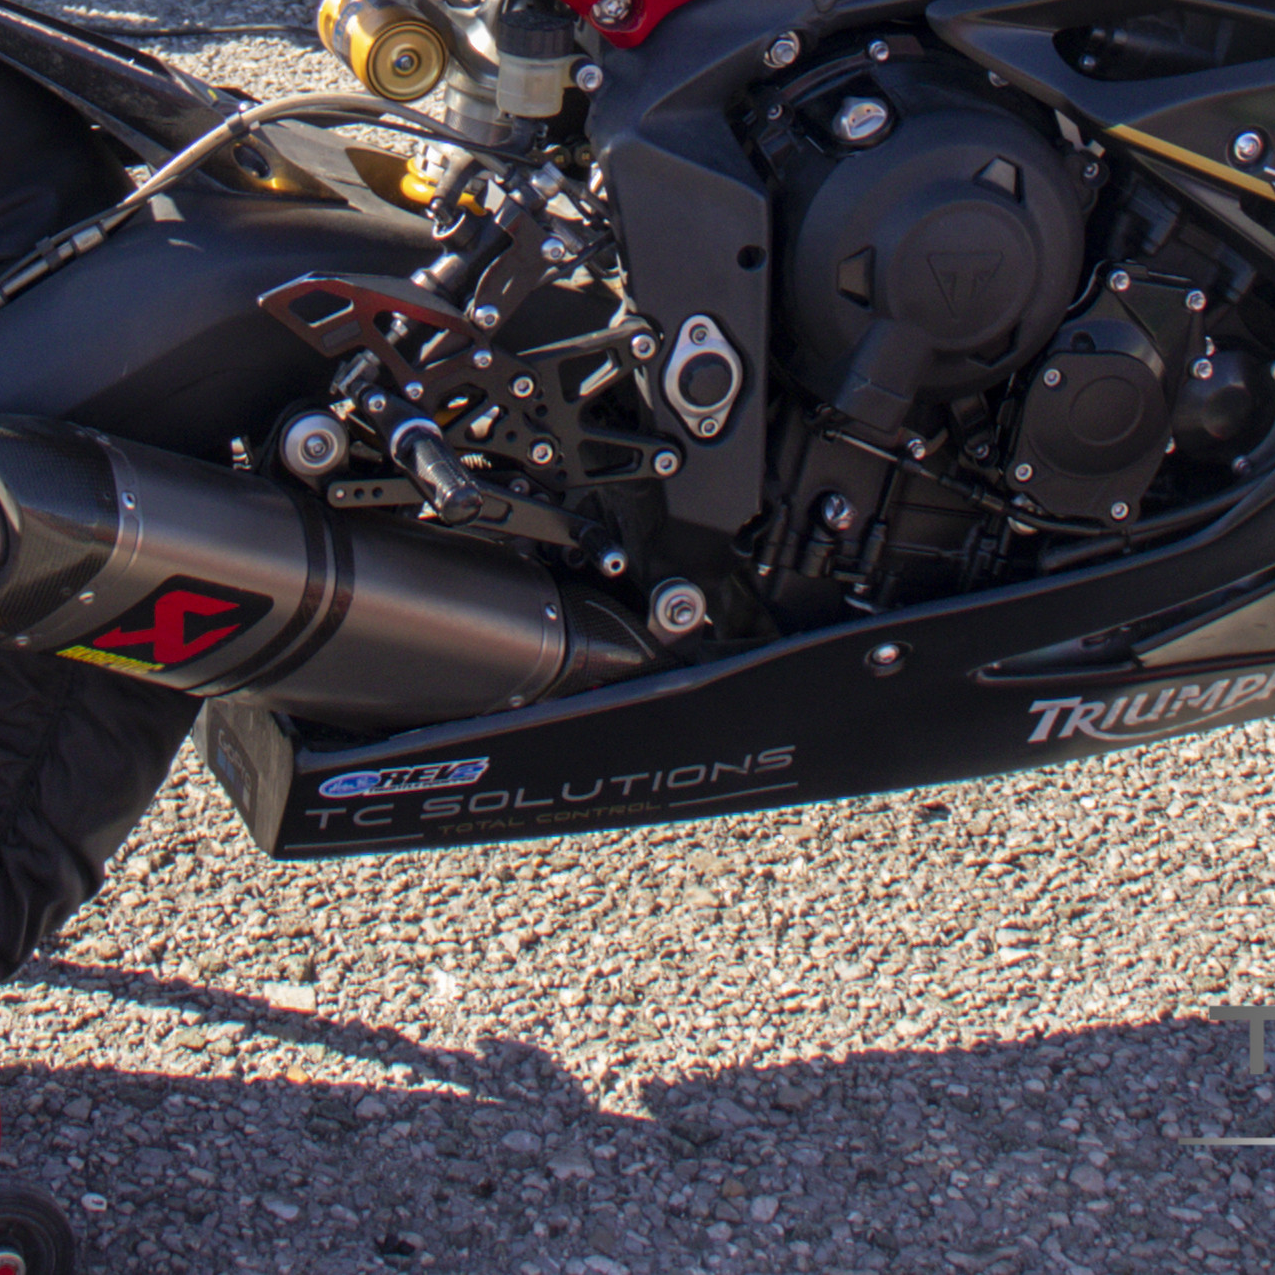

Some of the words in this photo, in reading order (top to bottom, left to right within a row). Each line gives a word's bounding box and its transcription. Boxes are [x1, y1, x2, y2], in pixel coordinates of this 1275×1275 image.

[304, 802, 395, 831] TC
[419, 745, 797, 820] SOLUTIONS
[437, 815, 526, 836] TOTAL
[535, 799, 663, 825] CONTROL
